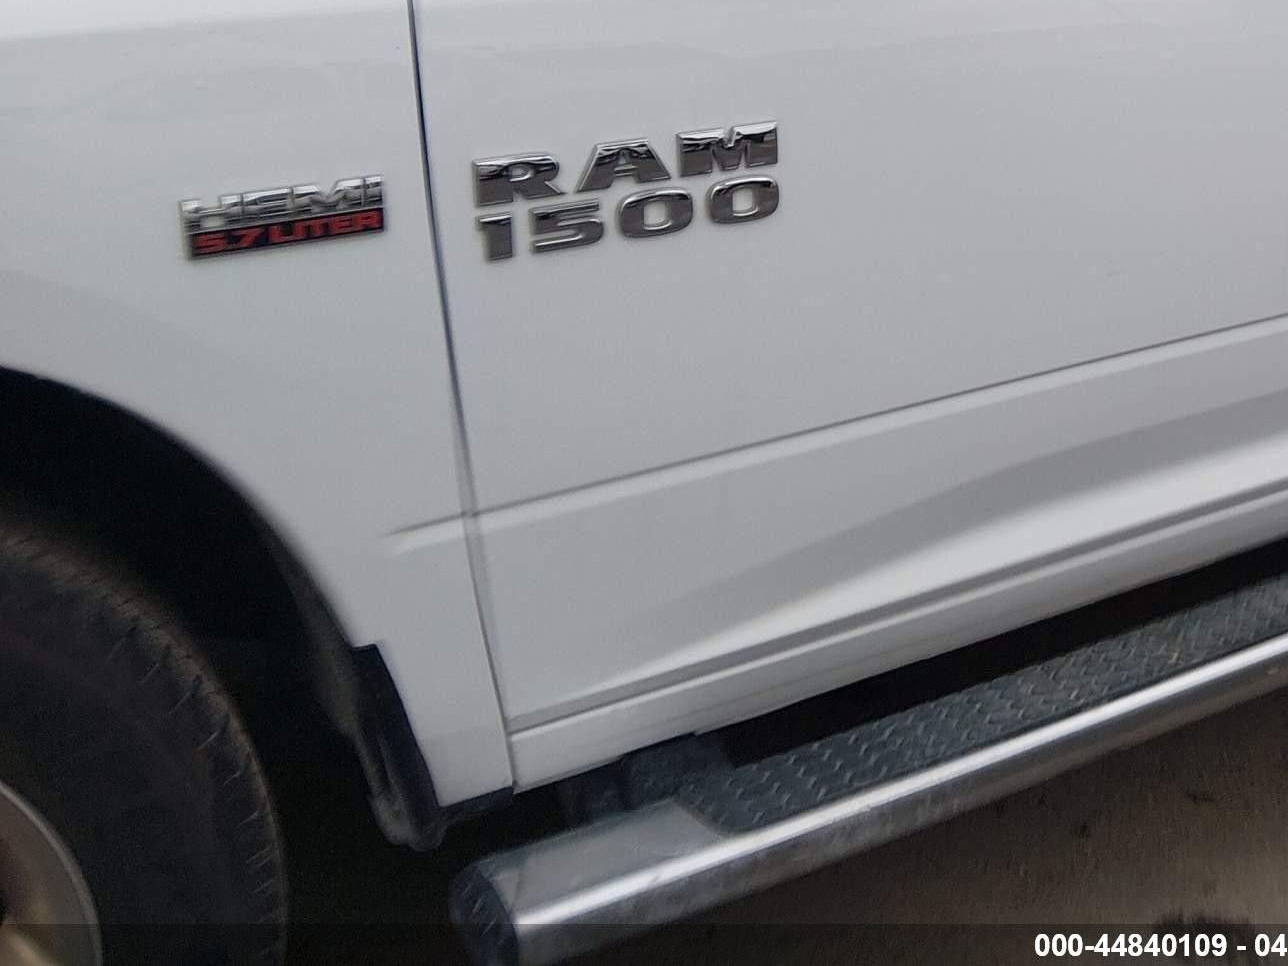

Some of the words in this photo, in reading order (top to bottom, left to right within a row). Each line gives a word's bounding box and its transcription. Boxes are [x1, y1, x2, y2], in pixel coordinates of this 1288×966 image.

[472, 121, 778, 207] RAM
[180, 175, 384, 234] HEMI
[267, 209, 383, 244] LITER
[476, 174, 779, 261] 1500
